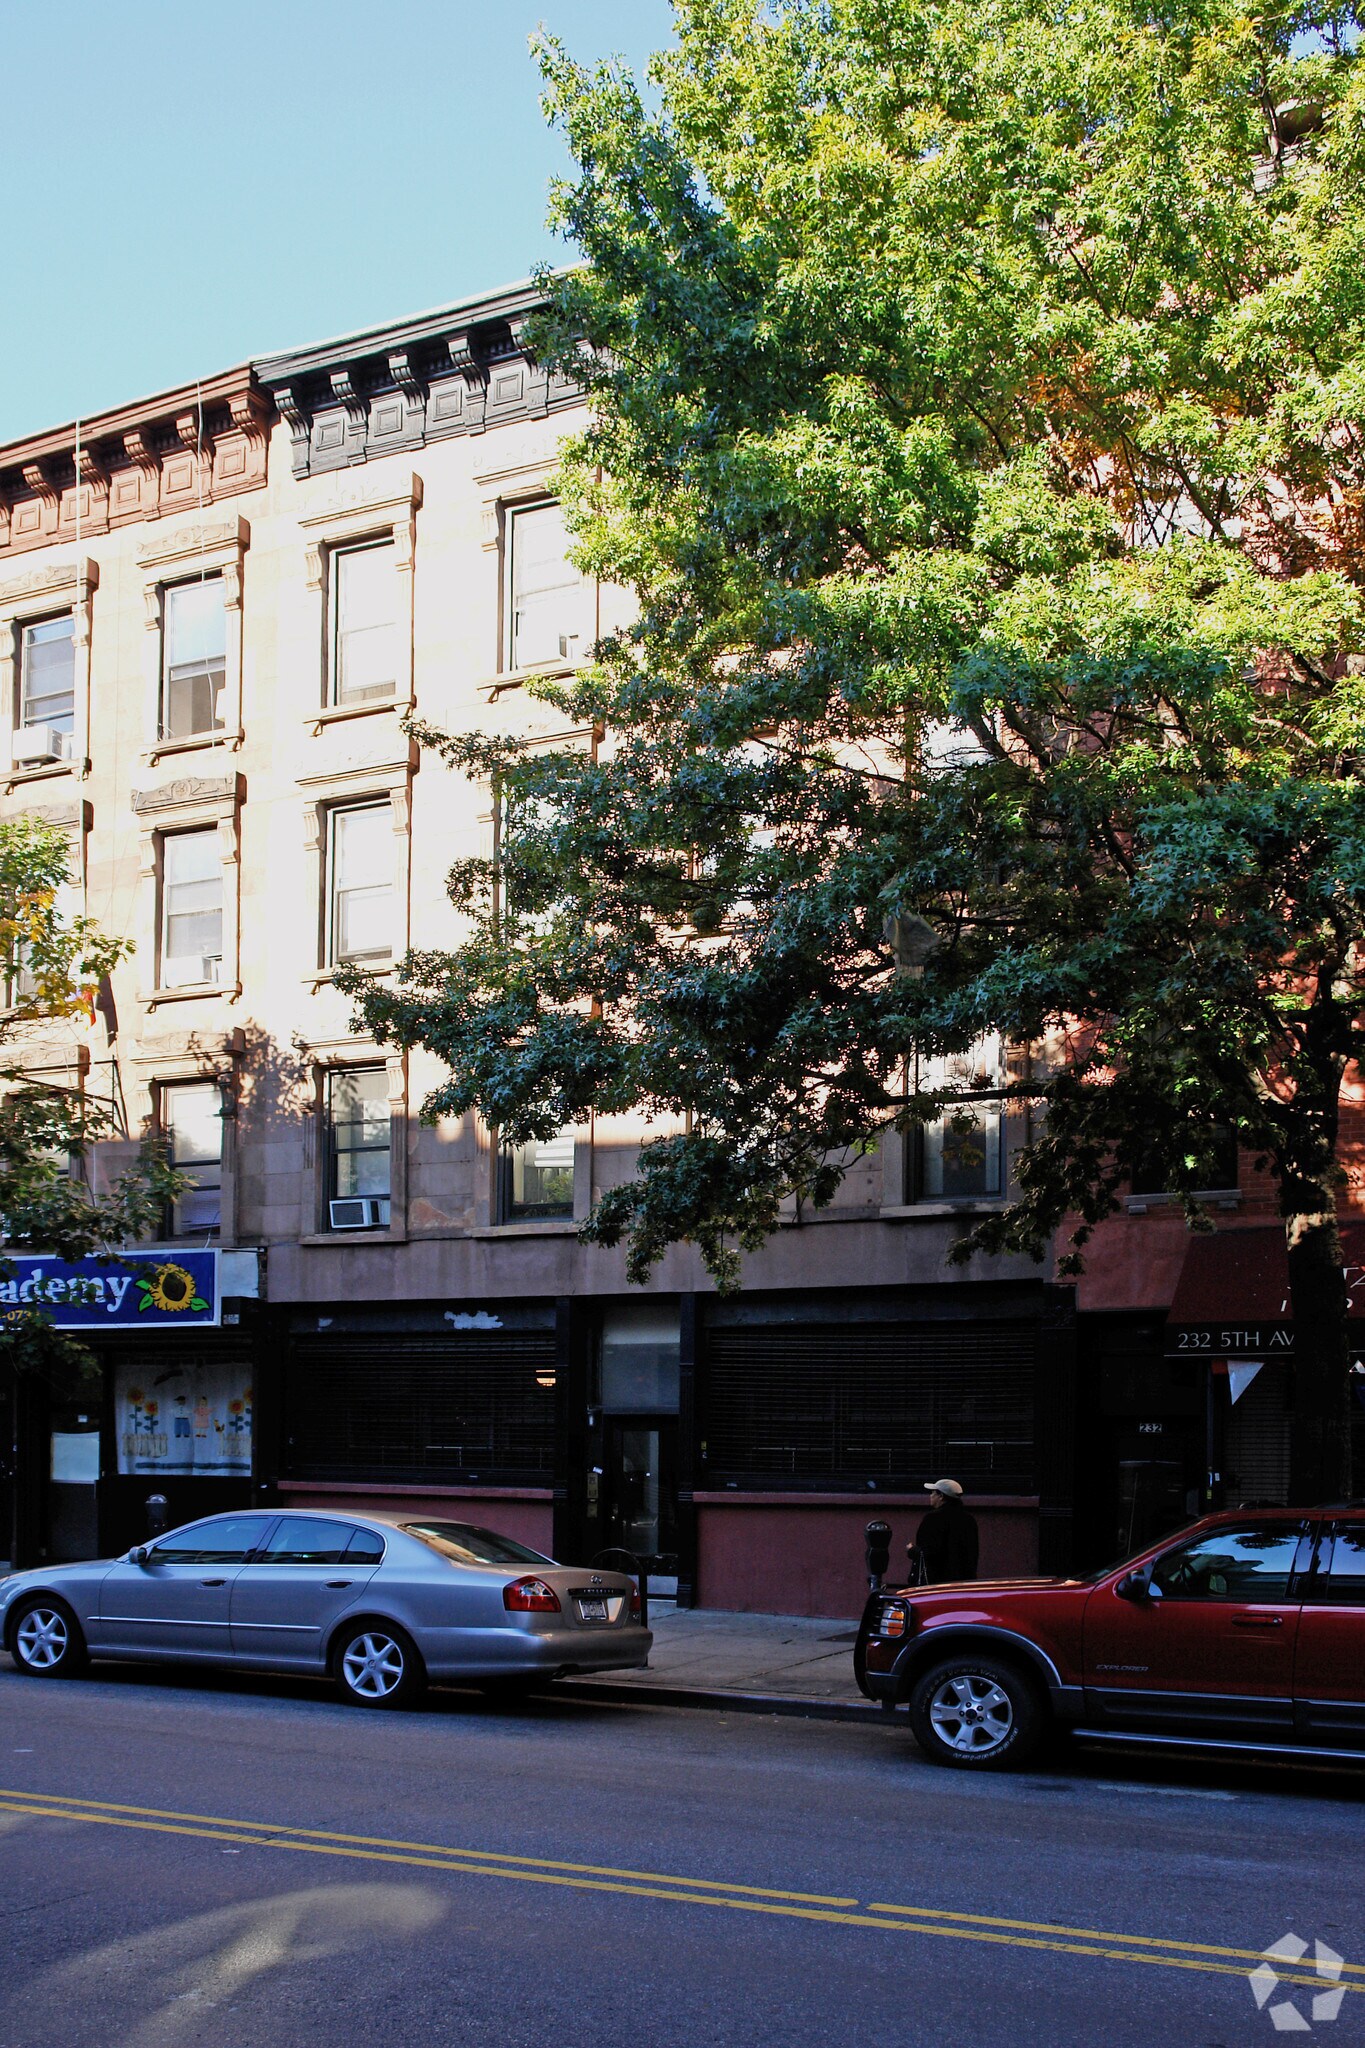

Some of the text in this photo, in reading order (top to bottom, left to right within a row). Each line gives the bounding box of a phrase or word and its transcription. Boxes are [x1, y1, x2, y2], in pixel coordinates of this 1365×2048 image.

[1178, 1332, 1211, 1348] 232
[1220, 1331, 1260, 1347] 5TH
[1140, 1423, 1162, 1433] 232
